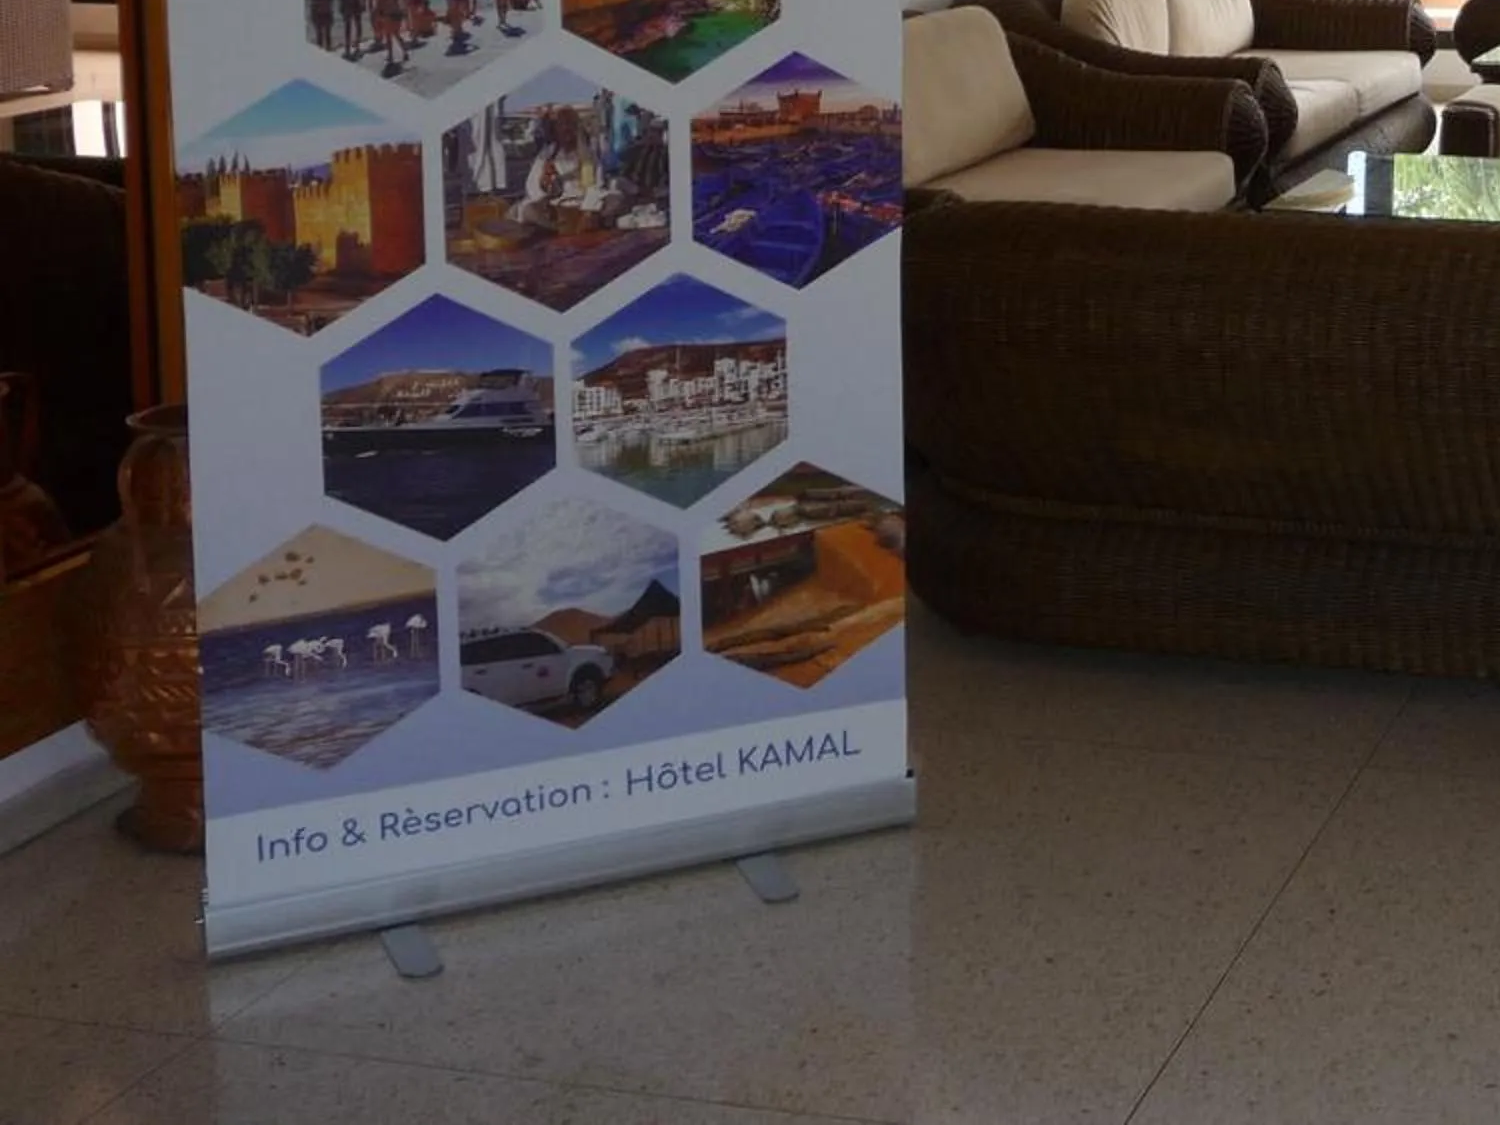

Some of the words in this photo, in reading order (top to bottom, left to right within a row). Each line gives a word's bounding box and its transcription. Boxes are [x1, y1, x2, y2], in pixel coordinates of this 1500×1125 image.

[257, 827, 329, 862] Info
[341, 817, 367, 847] &
[625, 751, 727, 796] Hôtel
[738, 729, 862, 775] KAMAL
